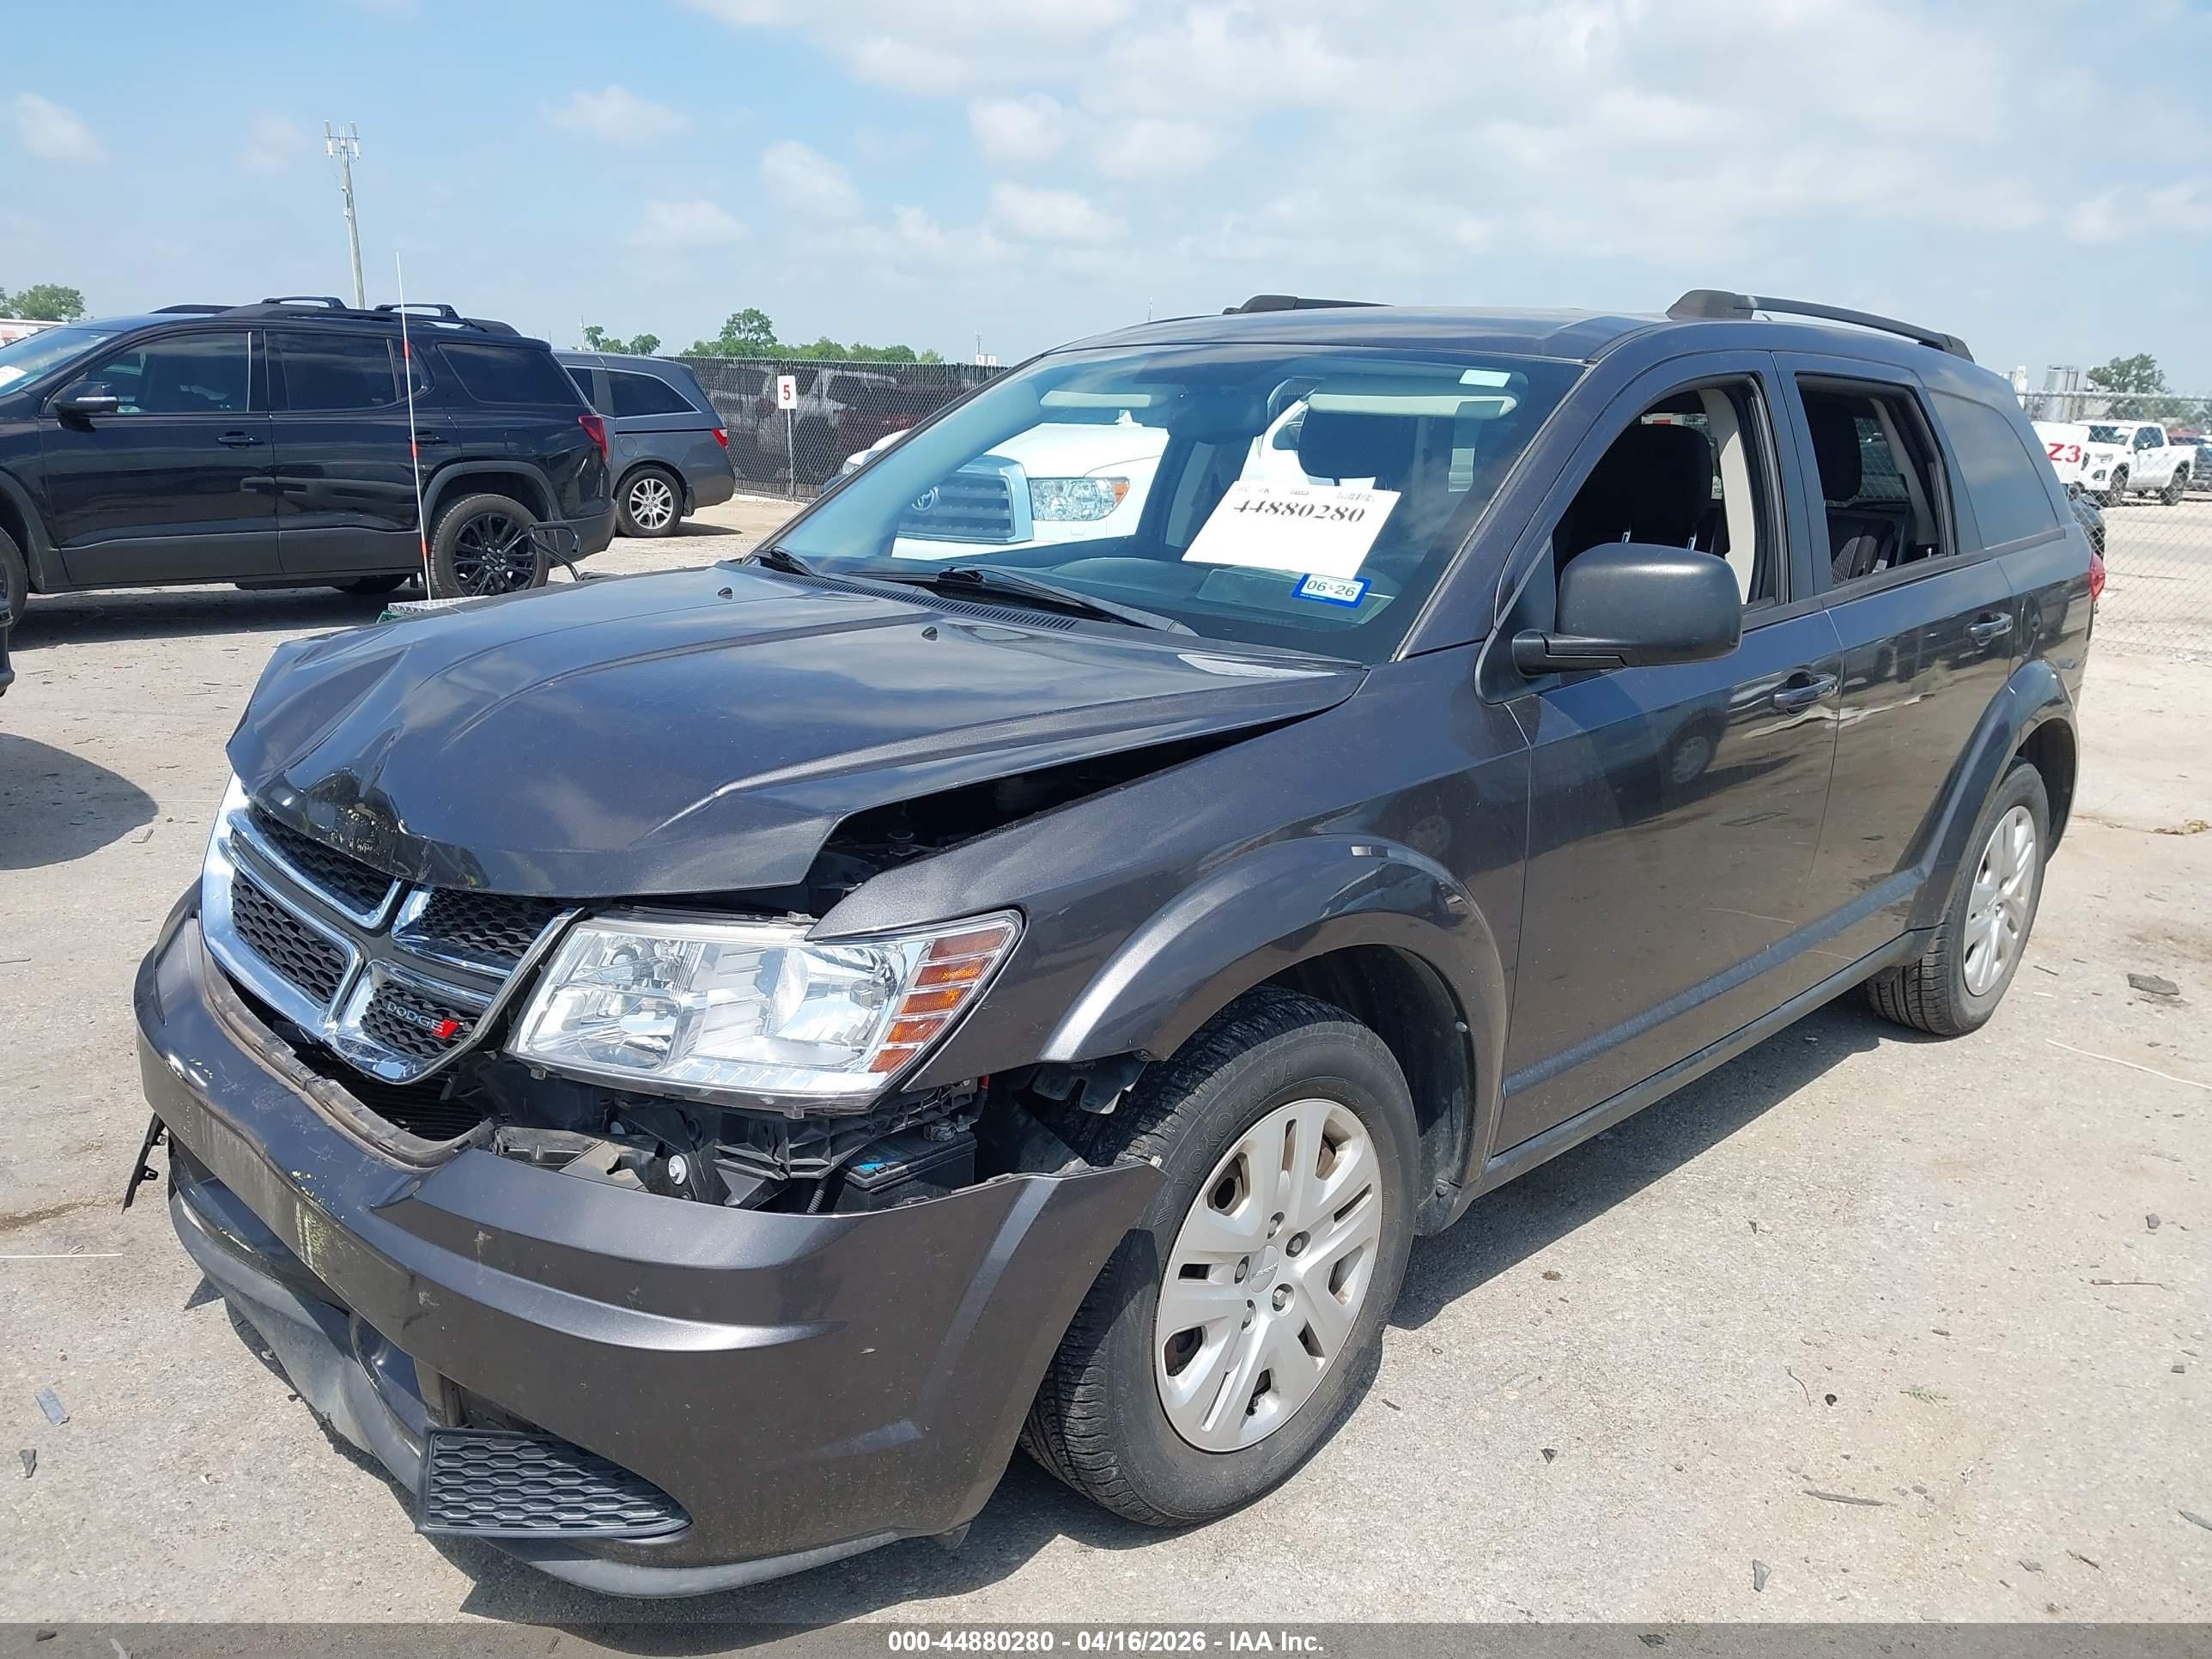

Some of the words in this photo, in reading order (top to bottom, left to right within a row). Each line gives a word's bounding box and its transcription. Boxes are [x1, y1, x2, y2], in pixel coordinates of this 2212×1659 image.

[783, 384, 791, 400] 5
[2047, 442, 2081, 463] Z3
[1233, 499, 1365, 523] 44880280
[1306, 580, 1328, 592] 06
[1334, 585, 1356, 597] 26
[387, 1001, 444, 1033] DODGE
